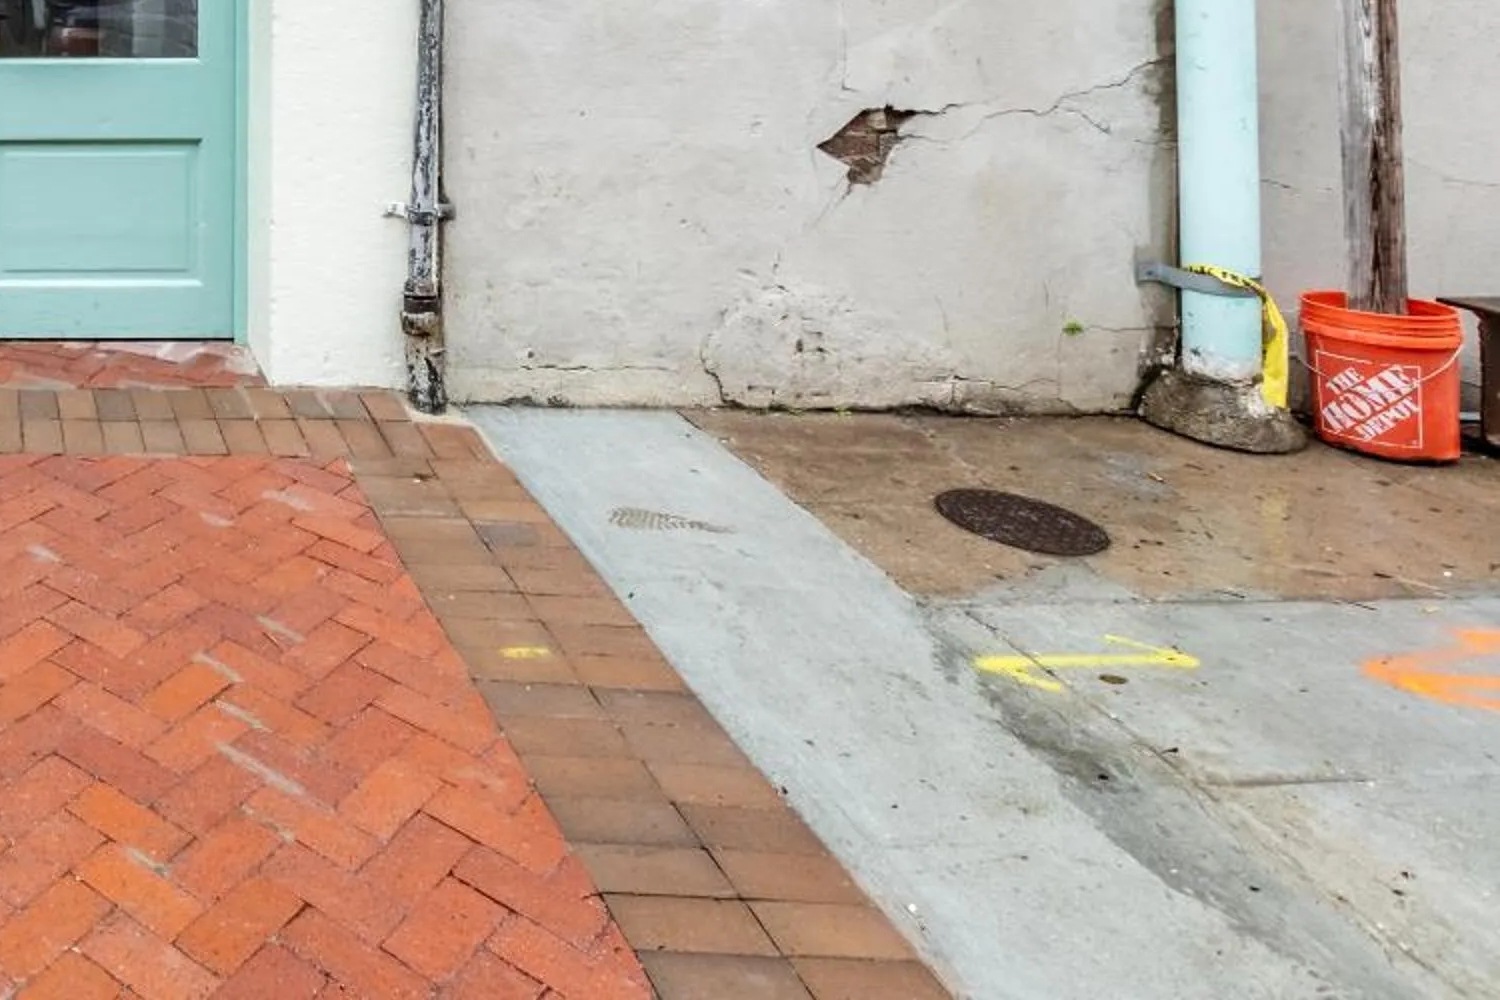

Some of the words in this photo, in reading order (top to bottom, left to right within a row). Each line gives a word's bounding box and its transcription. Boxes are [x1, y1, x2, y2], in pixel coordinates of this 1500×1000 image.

[1321, 365, 1414, 432] HOME
[1326, 366, 1365, 395] THE
[1354, 396, 1419, 441] DEPOT
